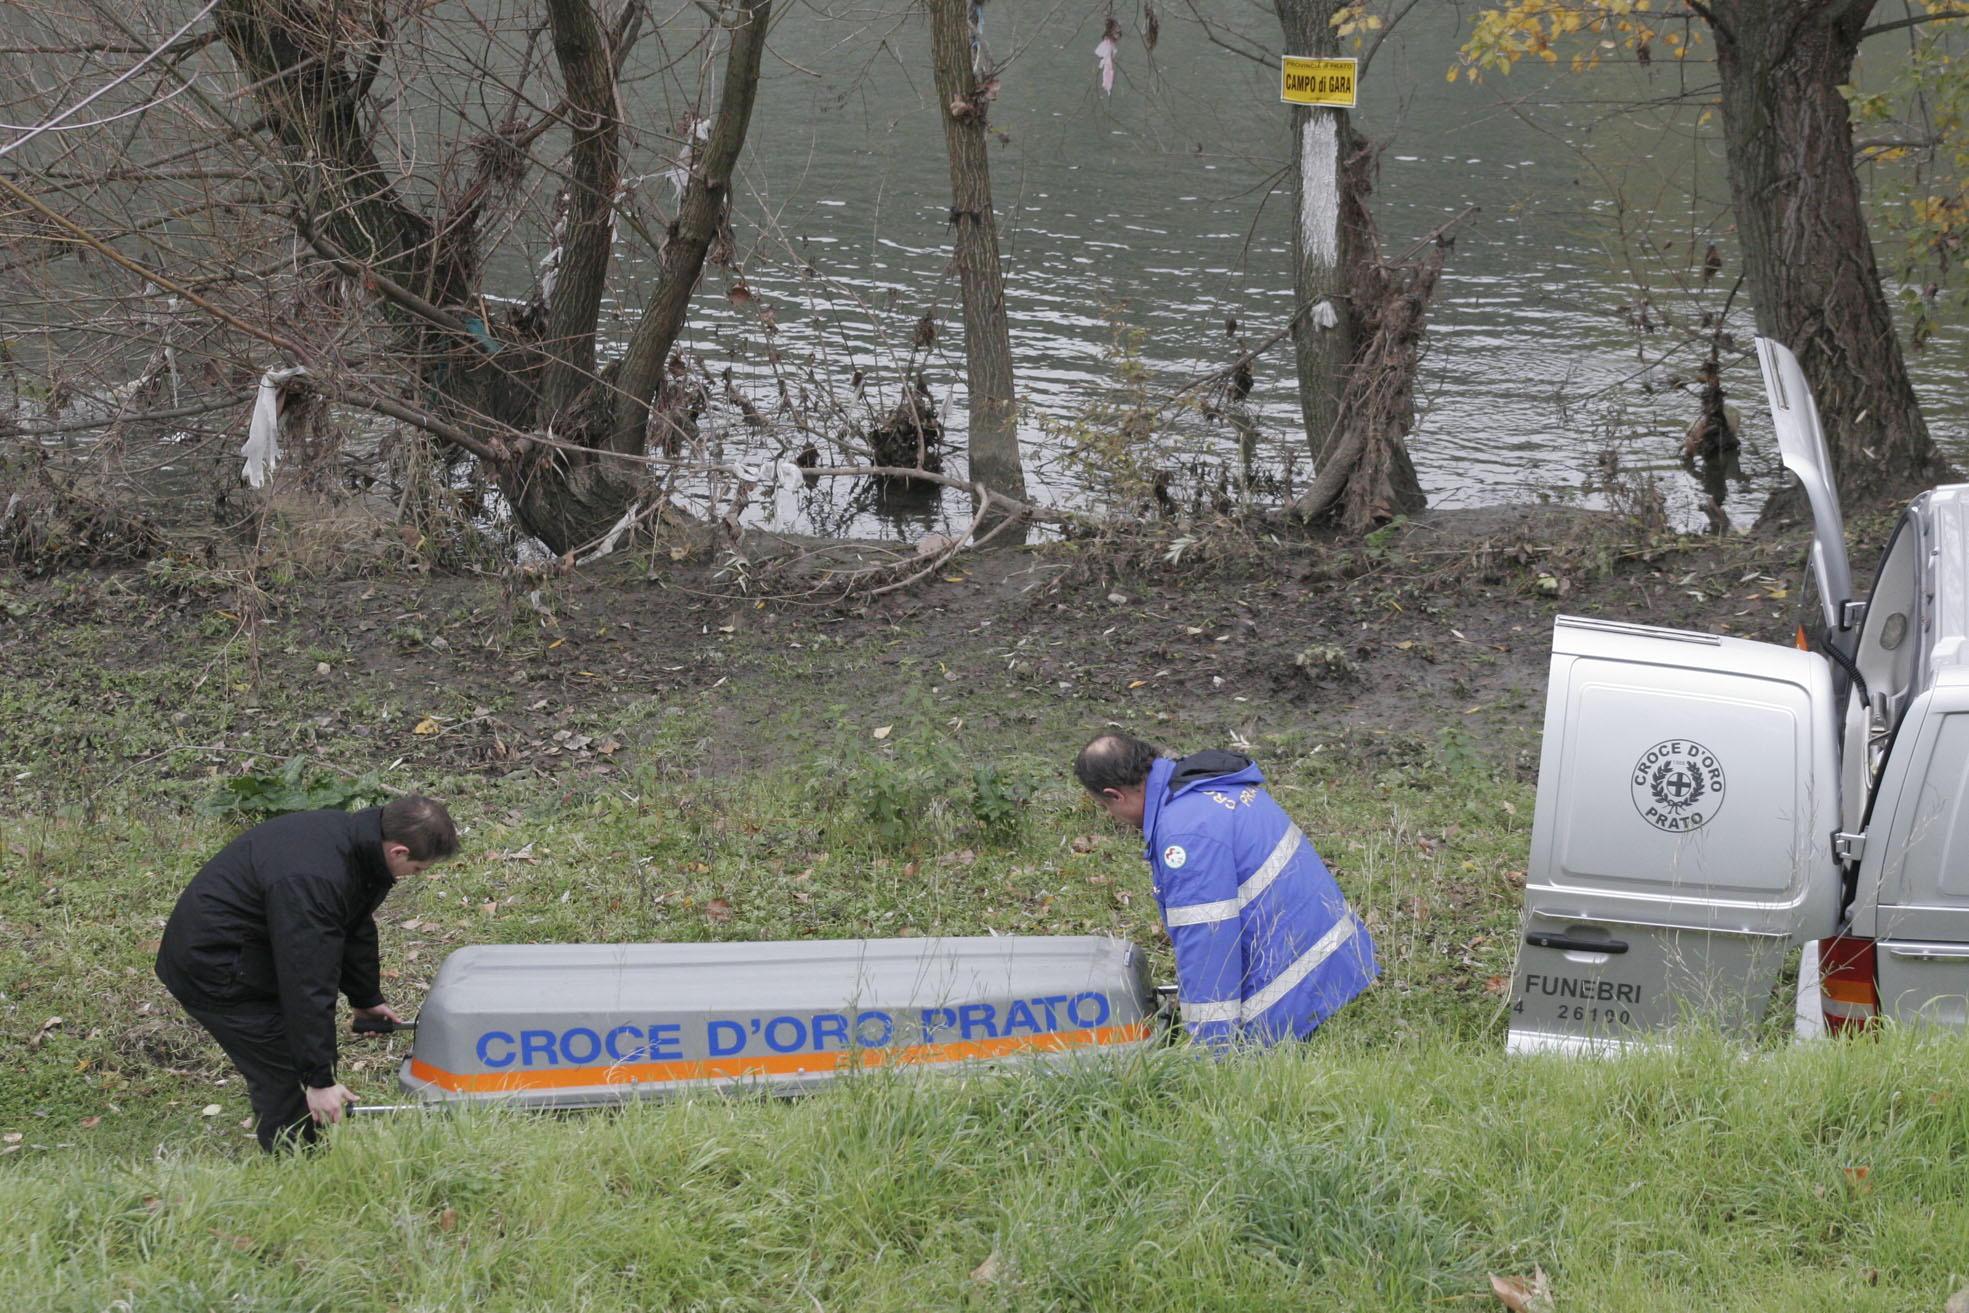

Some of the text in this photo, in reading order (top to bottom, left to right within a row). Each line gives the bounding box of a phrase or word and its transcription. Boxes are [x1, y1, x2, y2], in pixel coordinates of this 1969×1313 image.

[1286, 73, 1351, 94] CAMPO di GARA
[1634, 742, 1723, 792] CROCE D'ORO
[1645, 807, 1703, 829] PRATO
[1525, 974, 1641, 1004] FUNEBRI
[1513, 1000, 1524, 1014] 4
[476, 992, 1111, 1068] CROCE D'ORO PRATO
